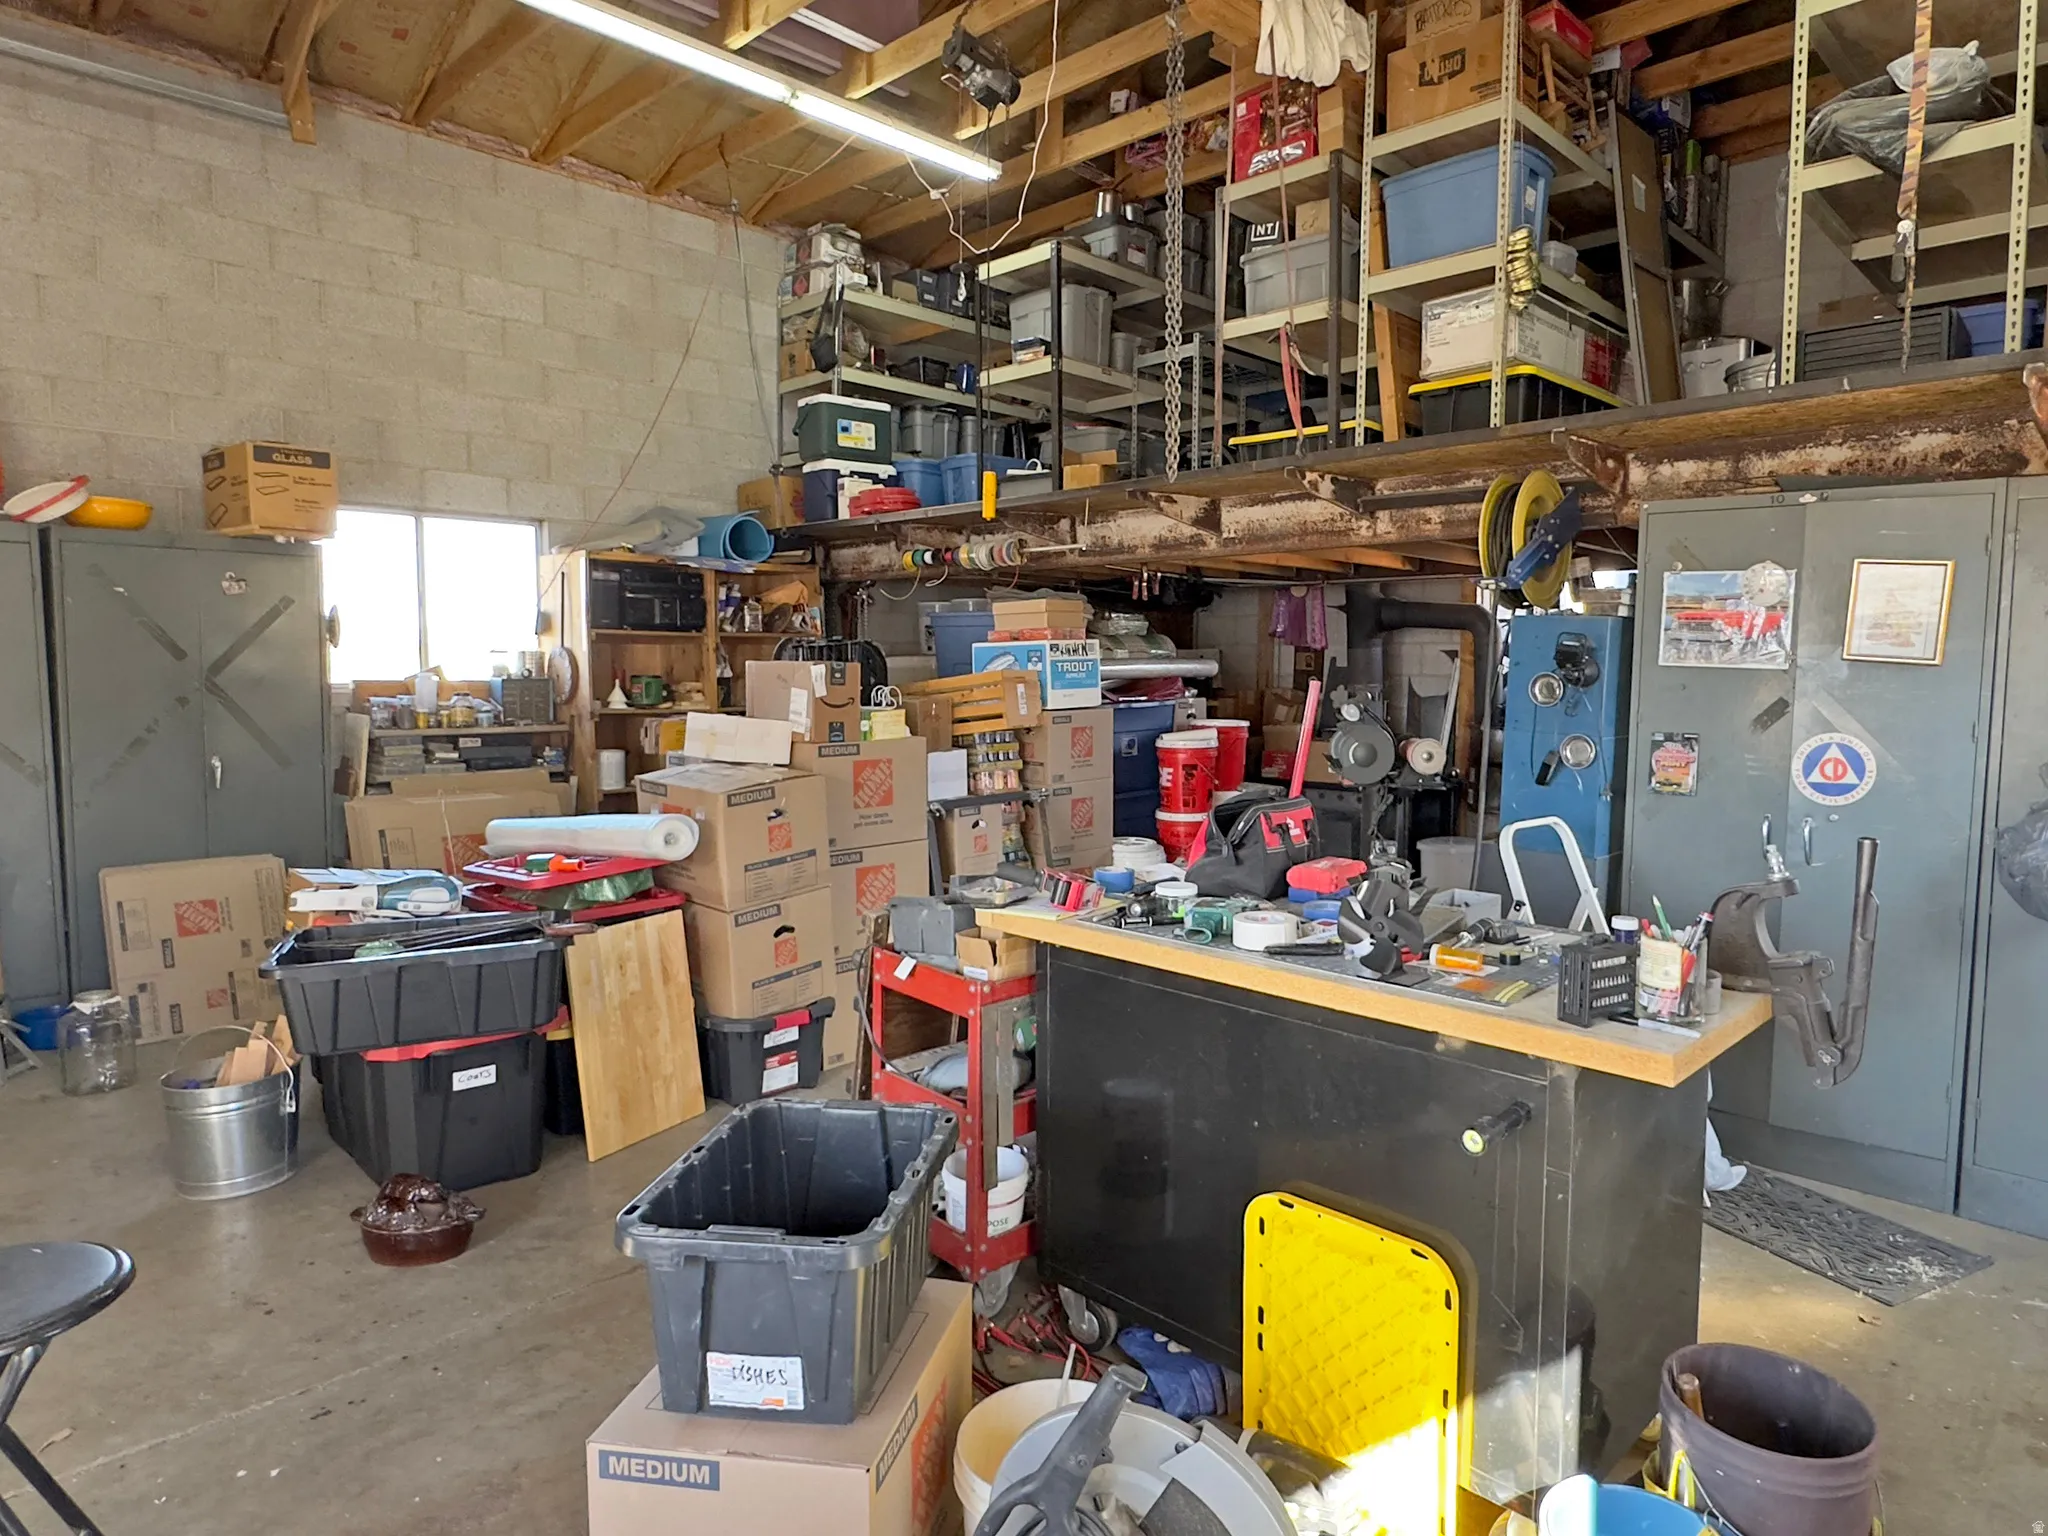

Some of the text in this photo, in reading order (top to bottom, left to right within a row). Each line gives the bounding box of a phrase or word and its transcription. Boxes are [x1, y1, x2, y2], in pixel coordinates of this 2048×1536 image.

[272, 453, 313, 465] GLASS
[1056, 661, 1093, 672] TROUT
[821, 745, 858, 756] MEDIUM
[731, 788, 772, 805] MEDIUM
[830, 852, 860, 865] EDIUM
[738, 905, 778, 924] MEDIUM
[878, 1402, 916, 1482] MEDIUM
[608, 1455, 710, 1485] MEDIUM
